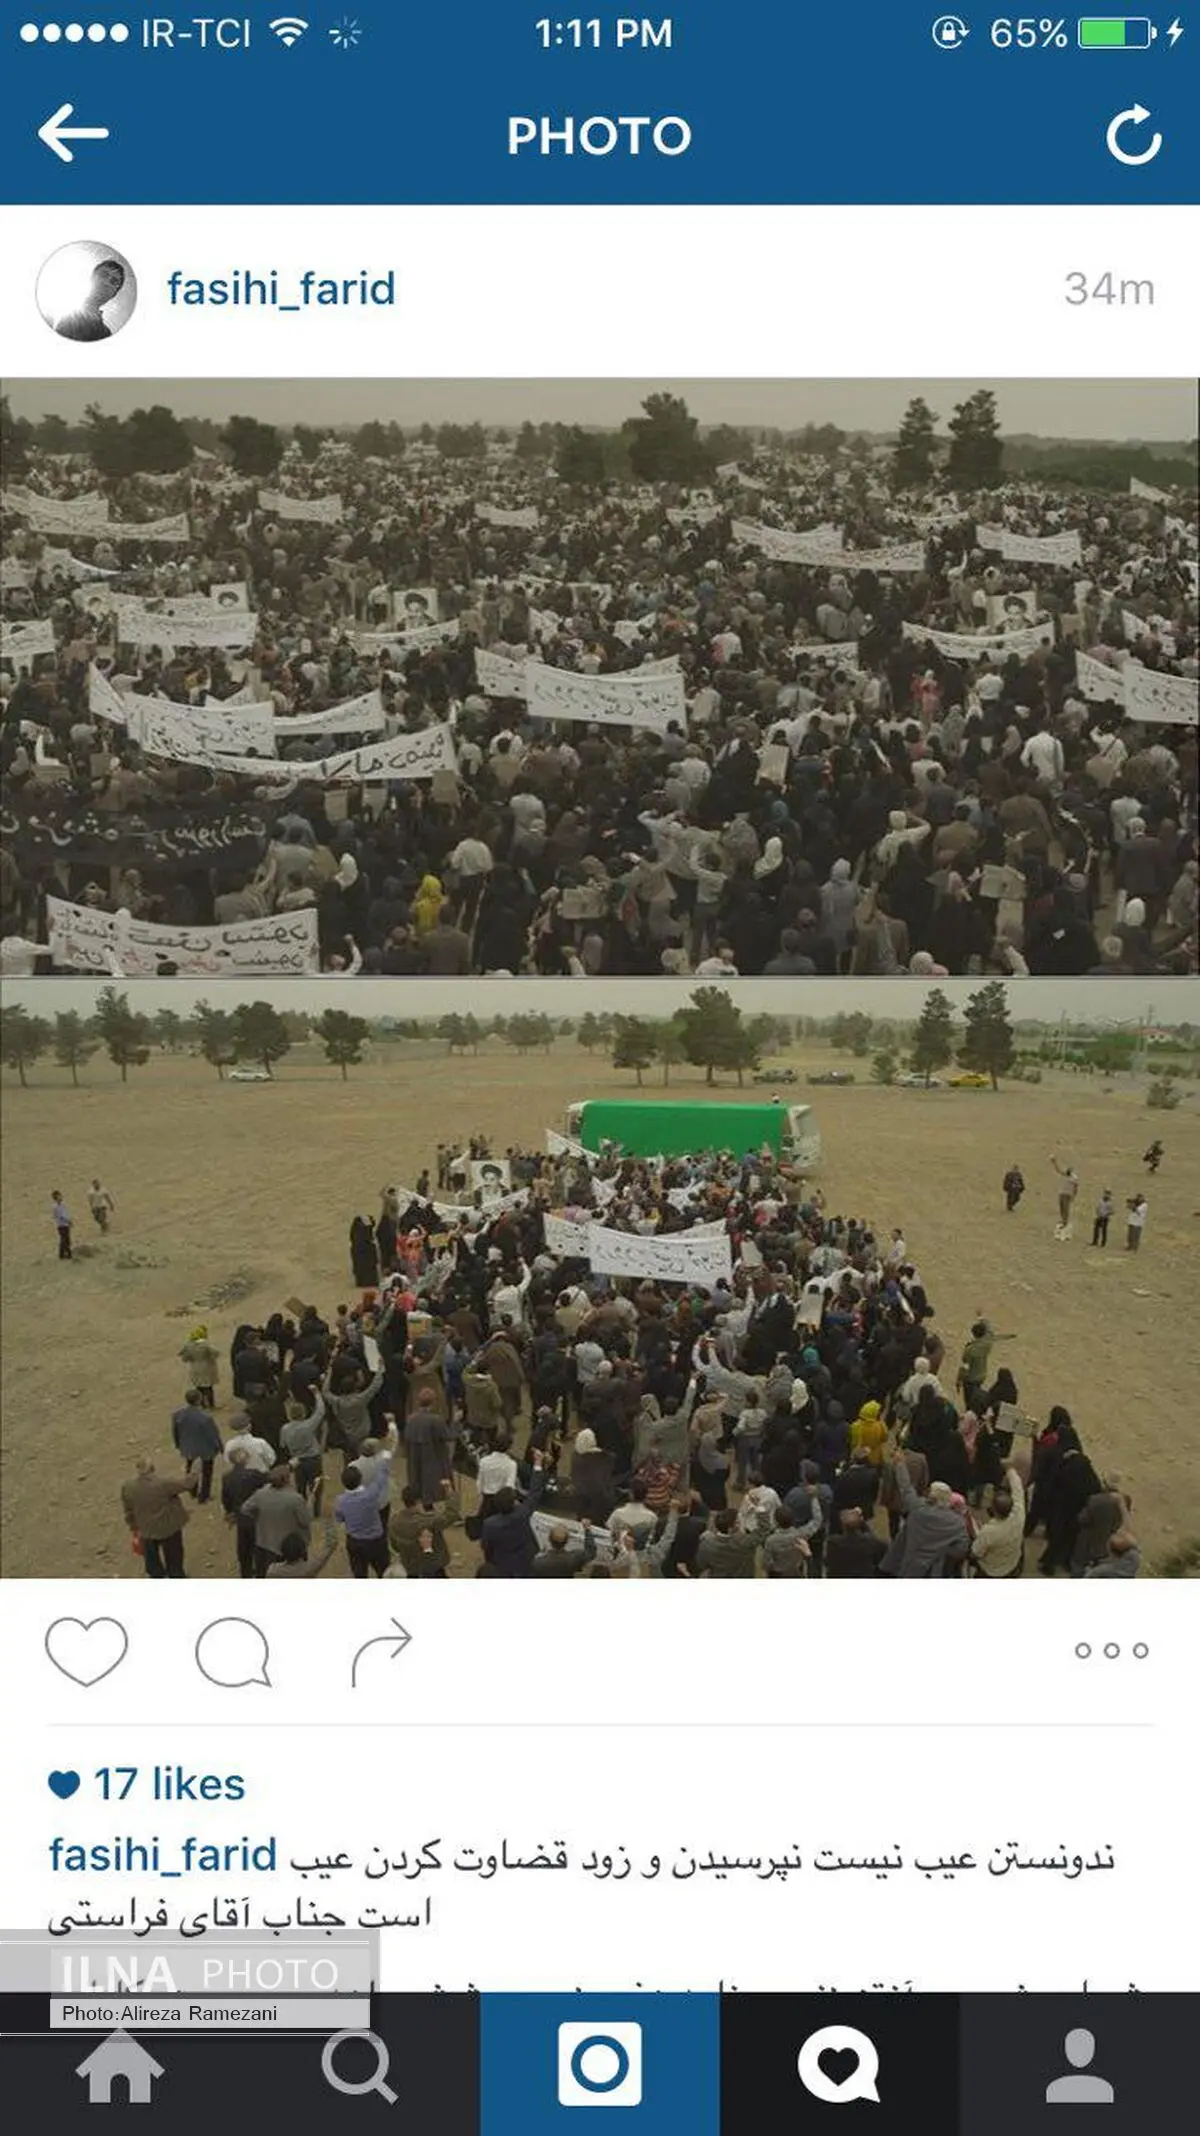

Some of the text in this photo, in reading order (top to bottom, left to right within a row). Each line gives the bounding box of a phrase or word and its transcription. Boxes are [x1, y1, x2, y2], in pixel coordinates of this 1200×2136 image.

[142, 18, 251, 49] IR-TCI
[535, 18, 672, 48] 1:11 PM
[990, 18, 1068, 49] 65%
[508, 115, 692, 157] PHOTO
[167, 269, 395, 312] fasihi_farid
[1065, 271, 1154, 305] 34m
[94, 1764, 246, 1801] 17 likes
[48, 1835, 1115, 1882] fasihi_farid ندونستن عیب نیست نپرسیدن و زود قضاوت کردن عیب
[45, 1896, 431, 1941] است جناب آقای فراستی
